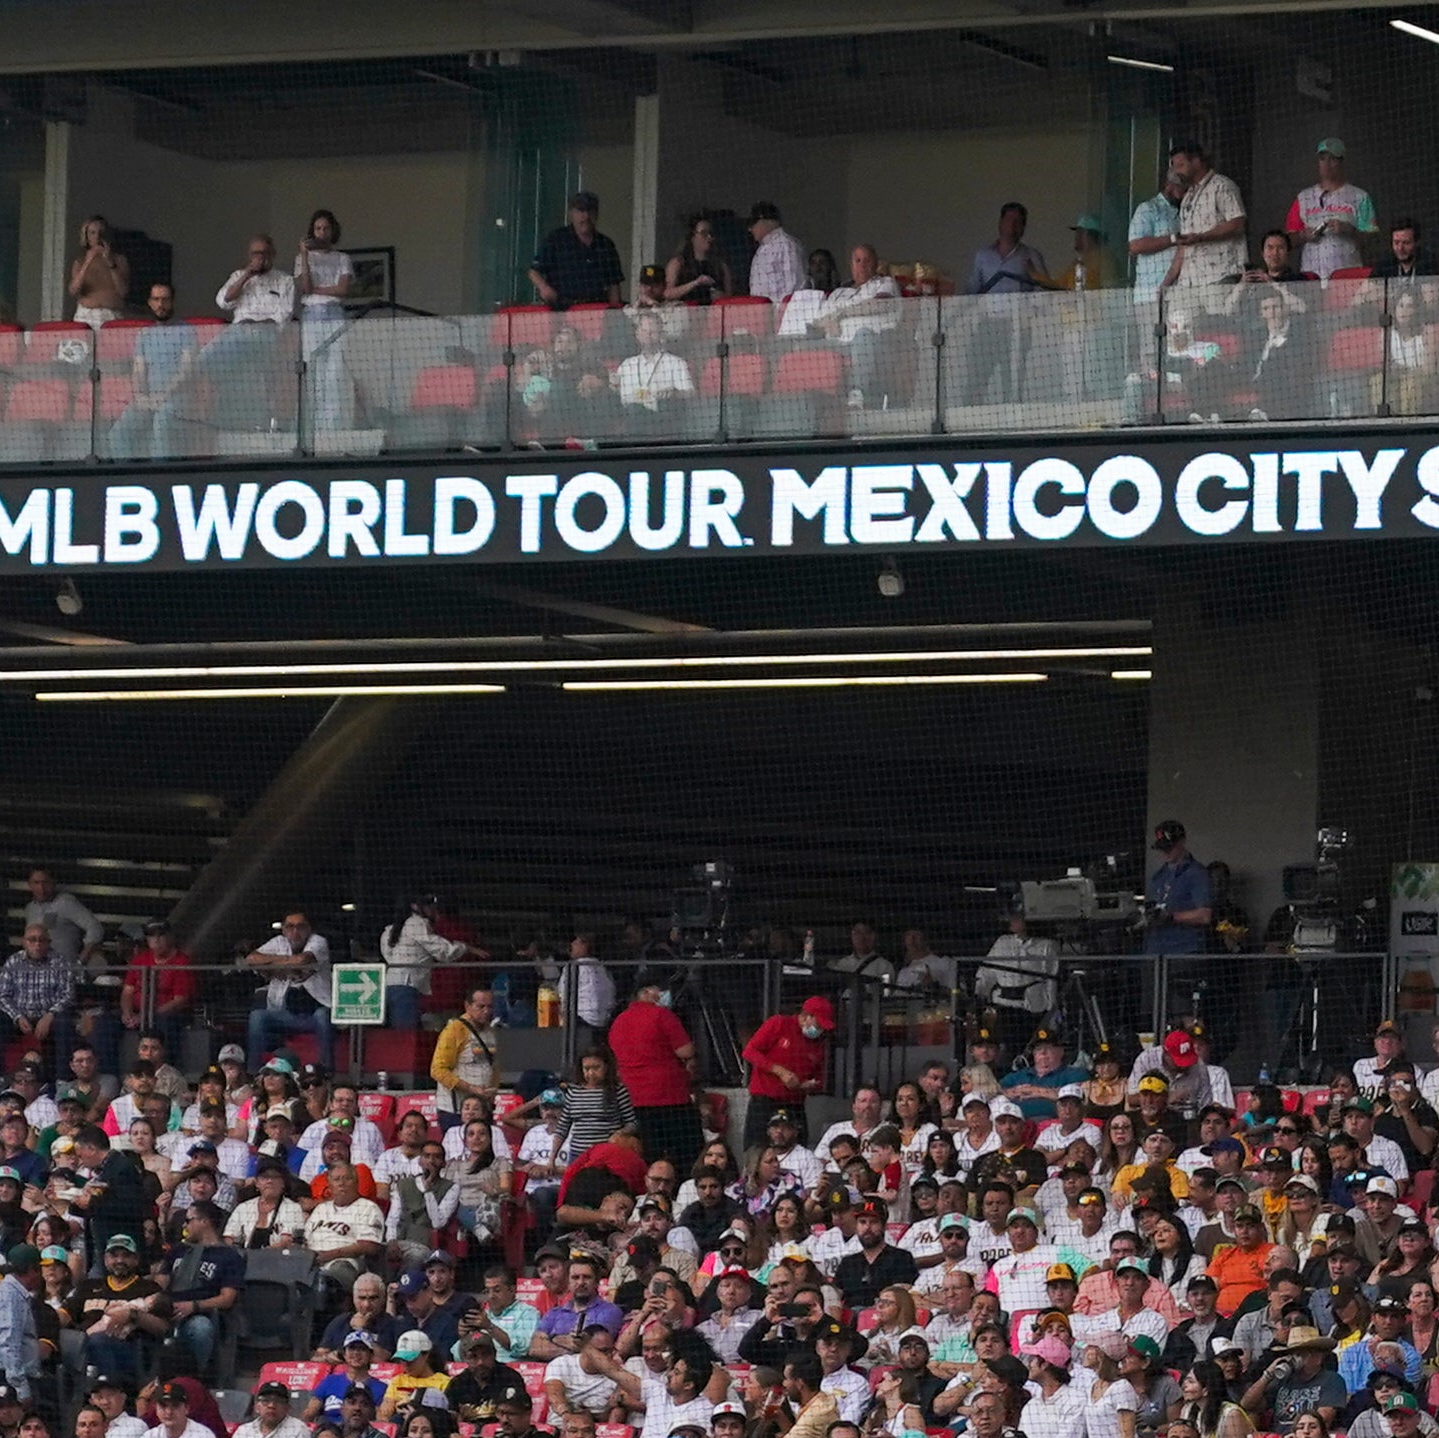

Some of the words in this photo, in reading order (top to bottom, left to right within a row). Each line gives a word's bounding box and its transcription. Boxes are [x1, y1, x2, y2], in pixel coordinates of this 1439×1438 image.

[173, 476, 495, 562] WORLD
[770, 455, 1163, 548] MEXICO
[1175, 449, 1405, 536] CITY
